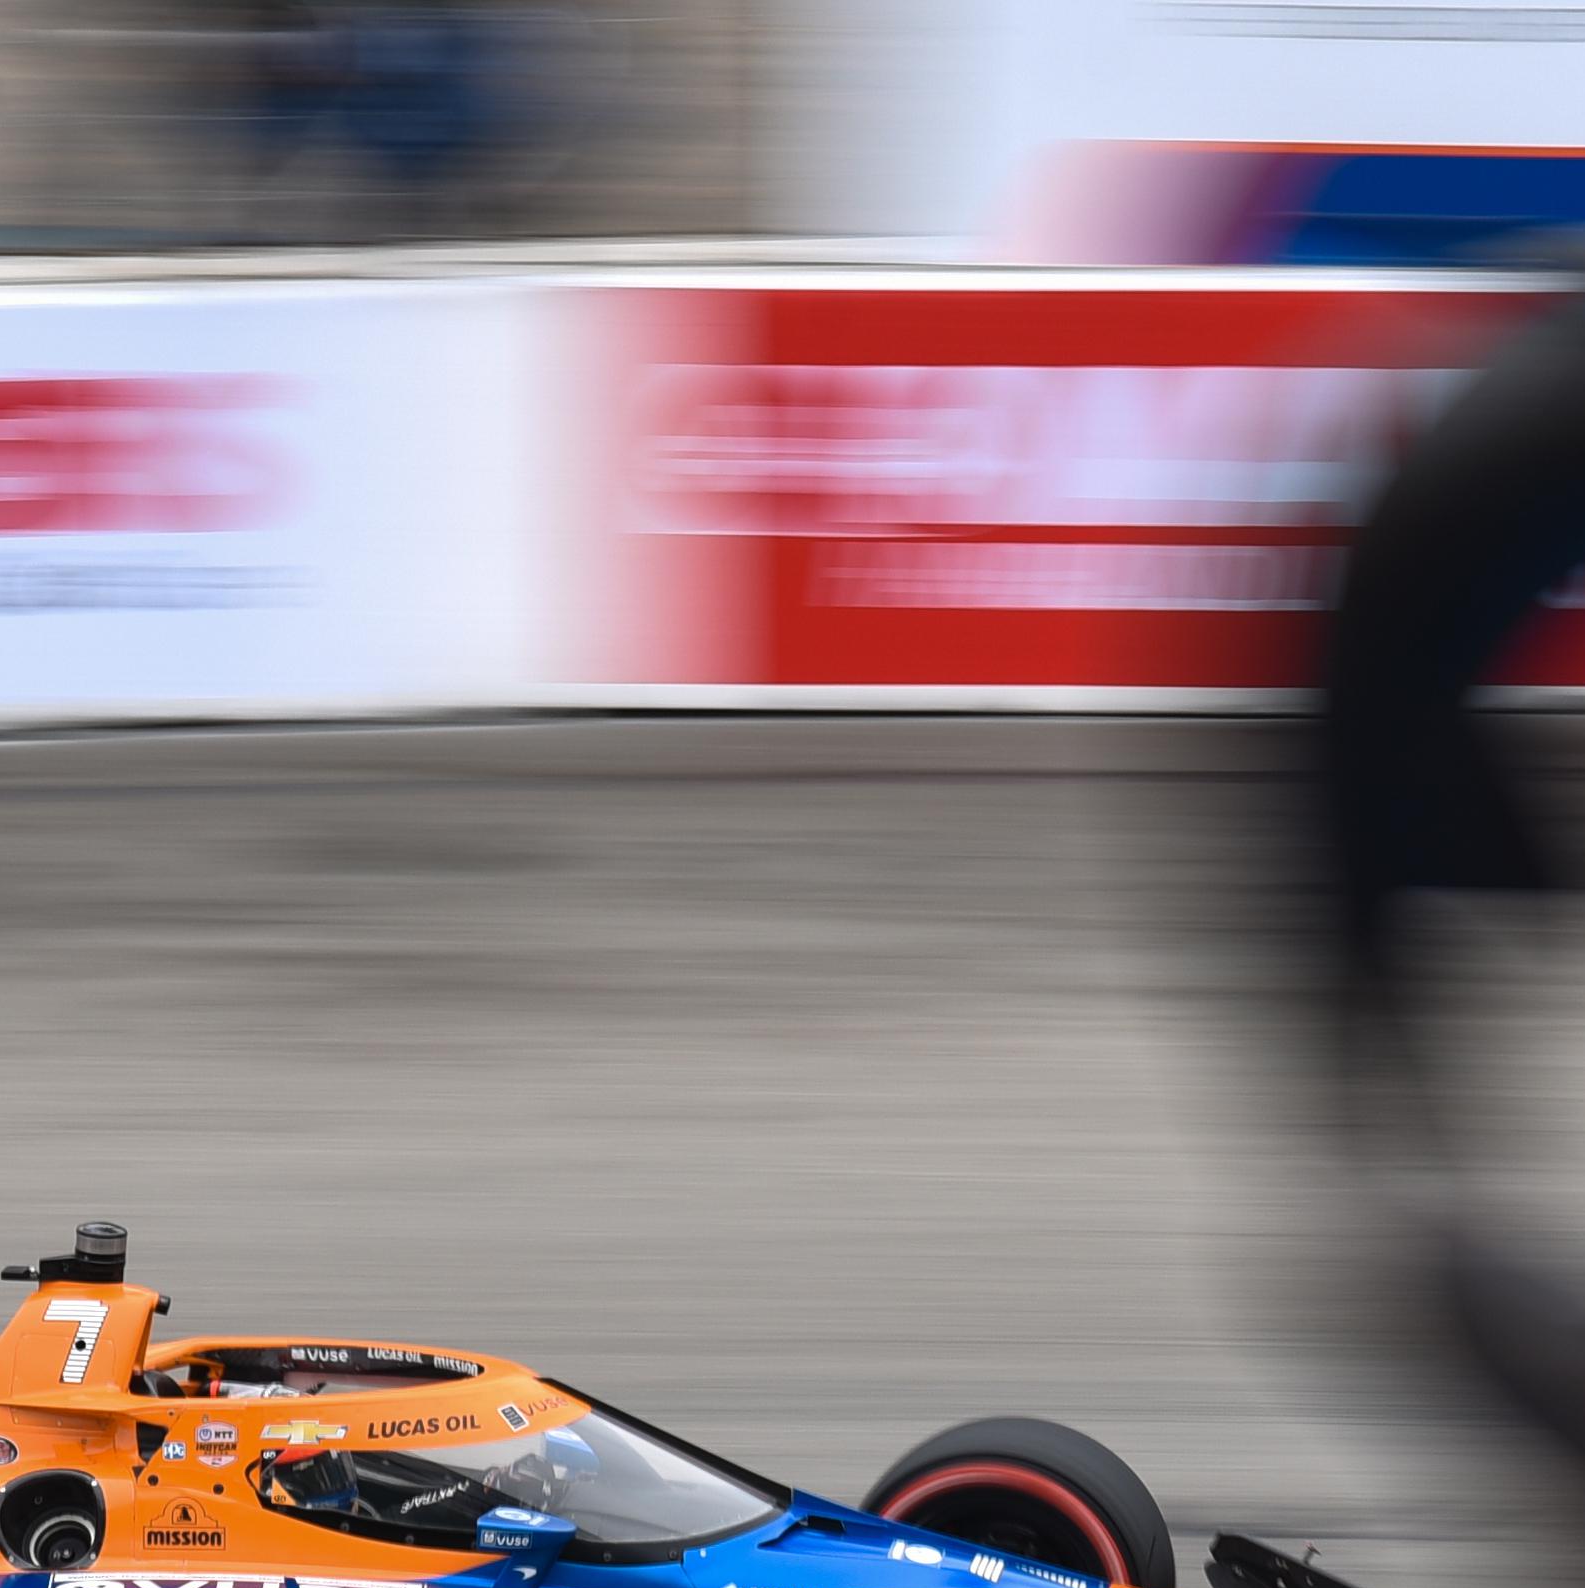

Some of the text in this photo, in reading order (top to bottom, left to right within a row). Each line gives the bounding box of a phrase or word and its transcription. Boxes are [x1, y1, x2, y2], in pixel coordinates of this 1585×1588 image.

[43, 1299, 109, 1384] 7
[367, 1414, 481, 1440] LUCAS OIL
